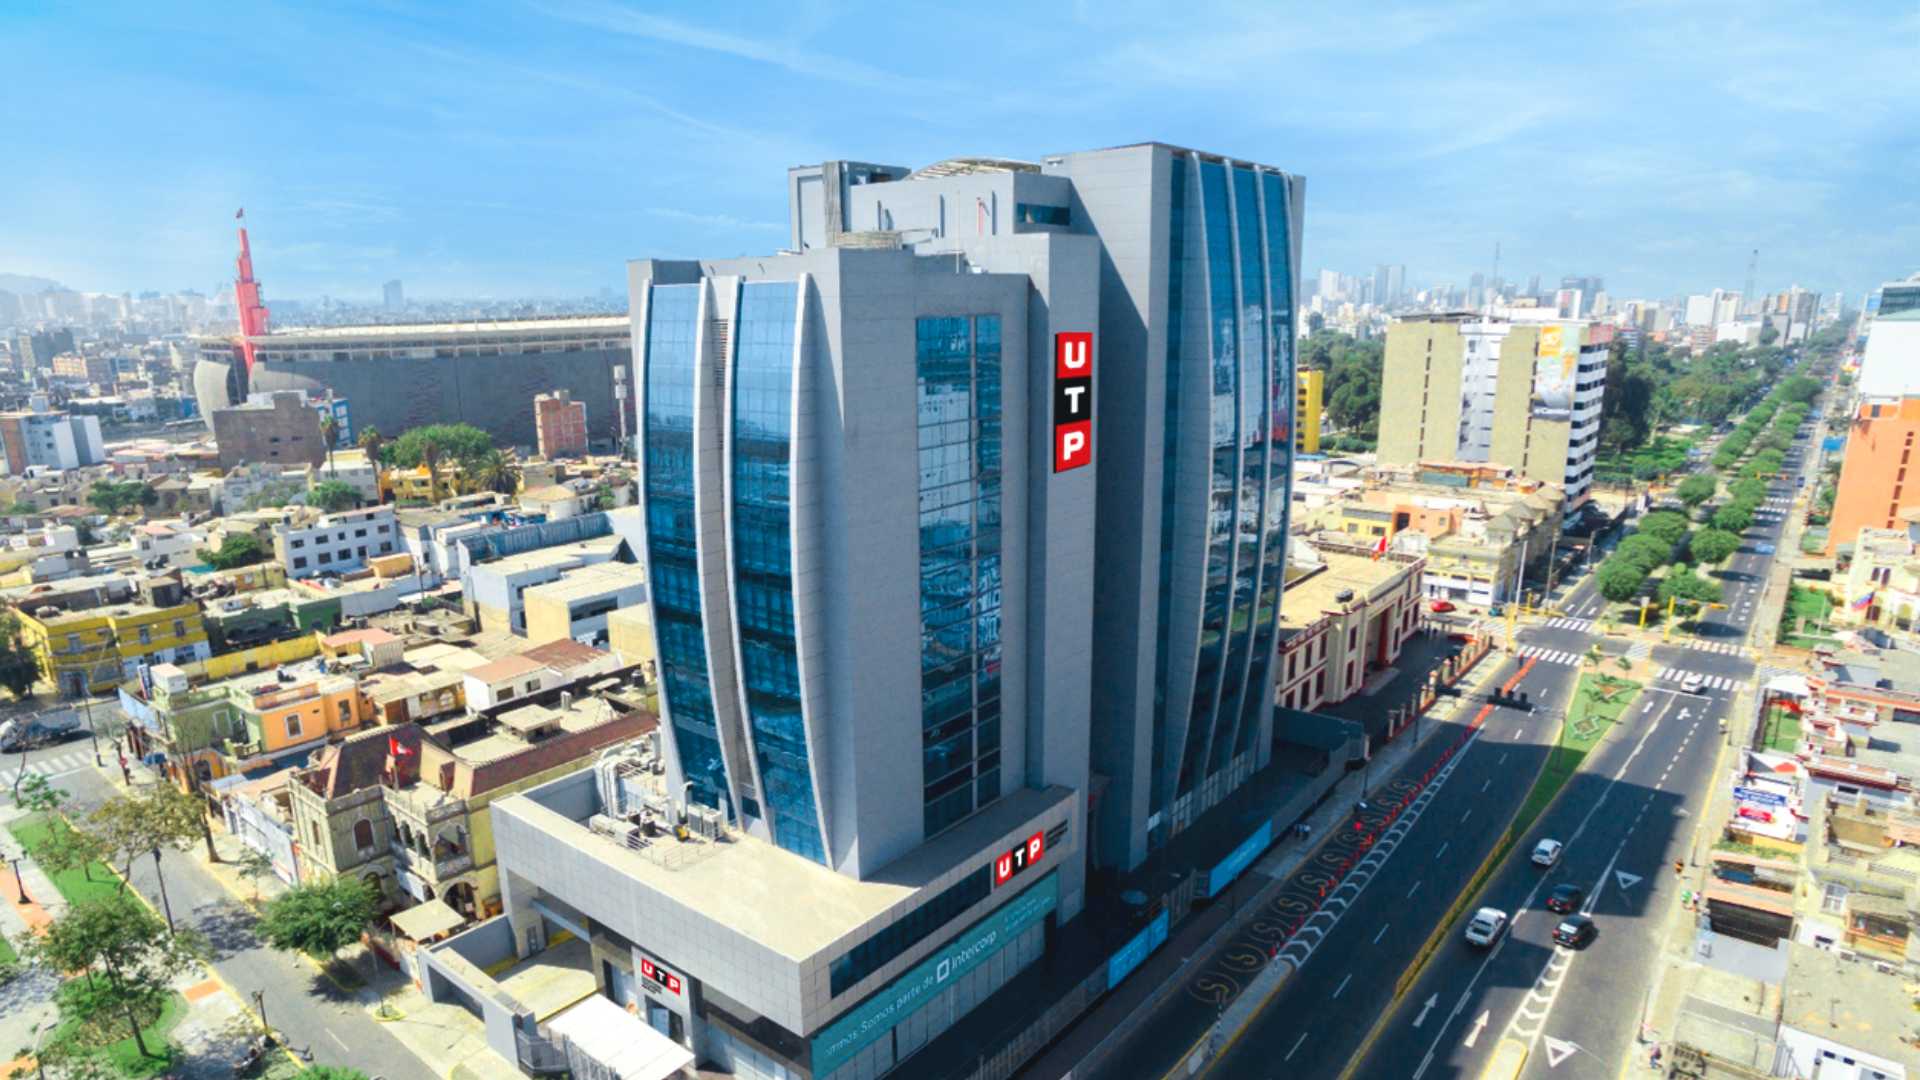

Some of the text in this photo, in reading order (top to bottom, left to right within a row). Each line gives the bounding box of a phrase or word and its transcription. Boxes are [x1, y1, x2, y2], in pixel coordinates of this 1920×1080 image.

[1063, 341, 1086, 461] UTP
[999, 837, 1041, 879] UTP
[643, 962, 680, 989] UTP
